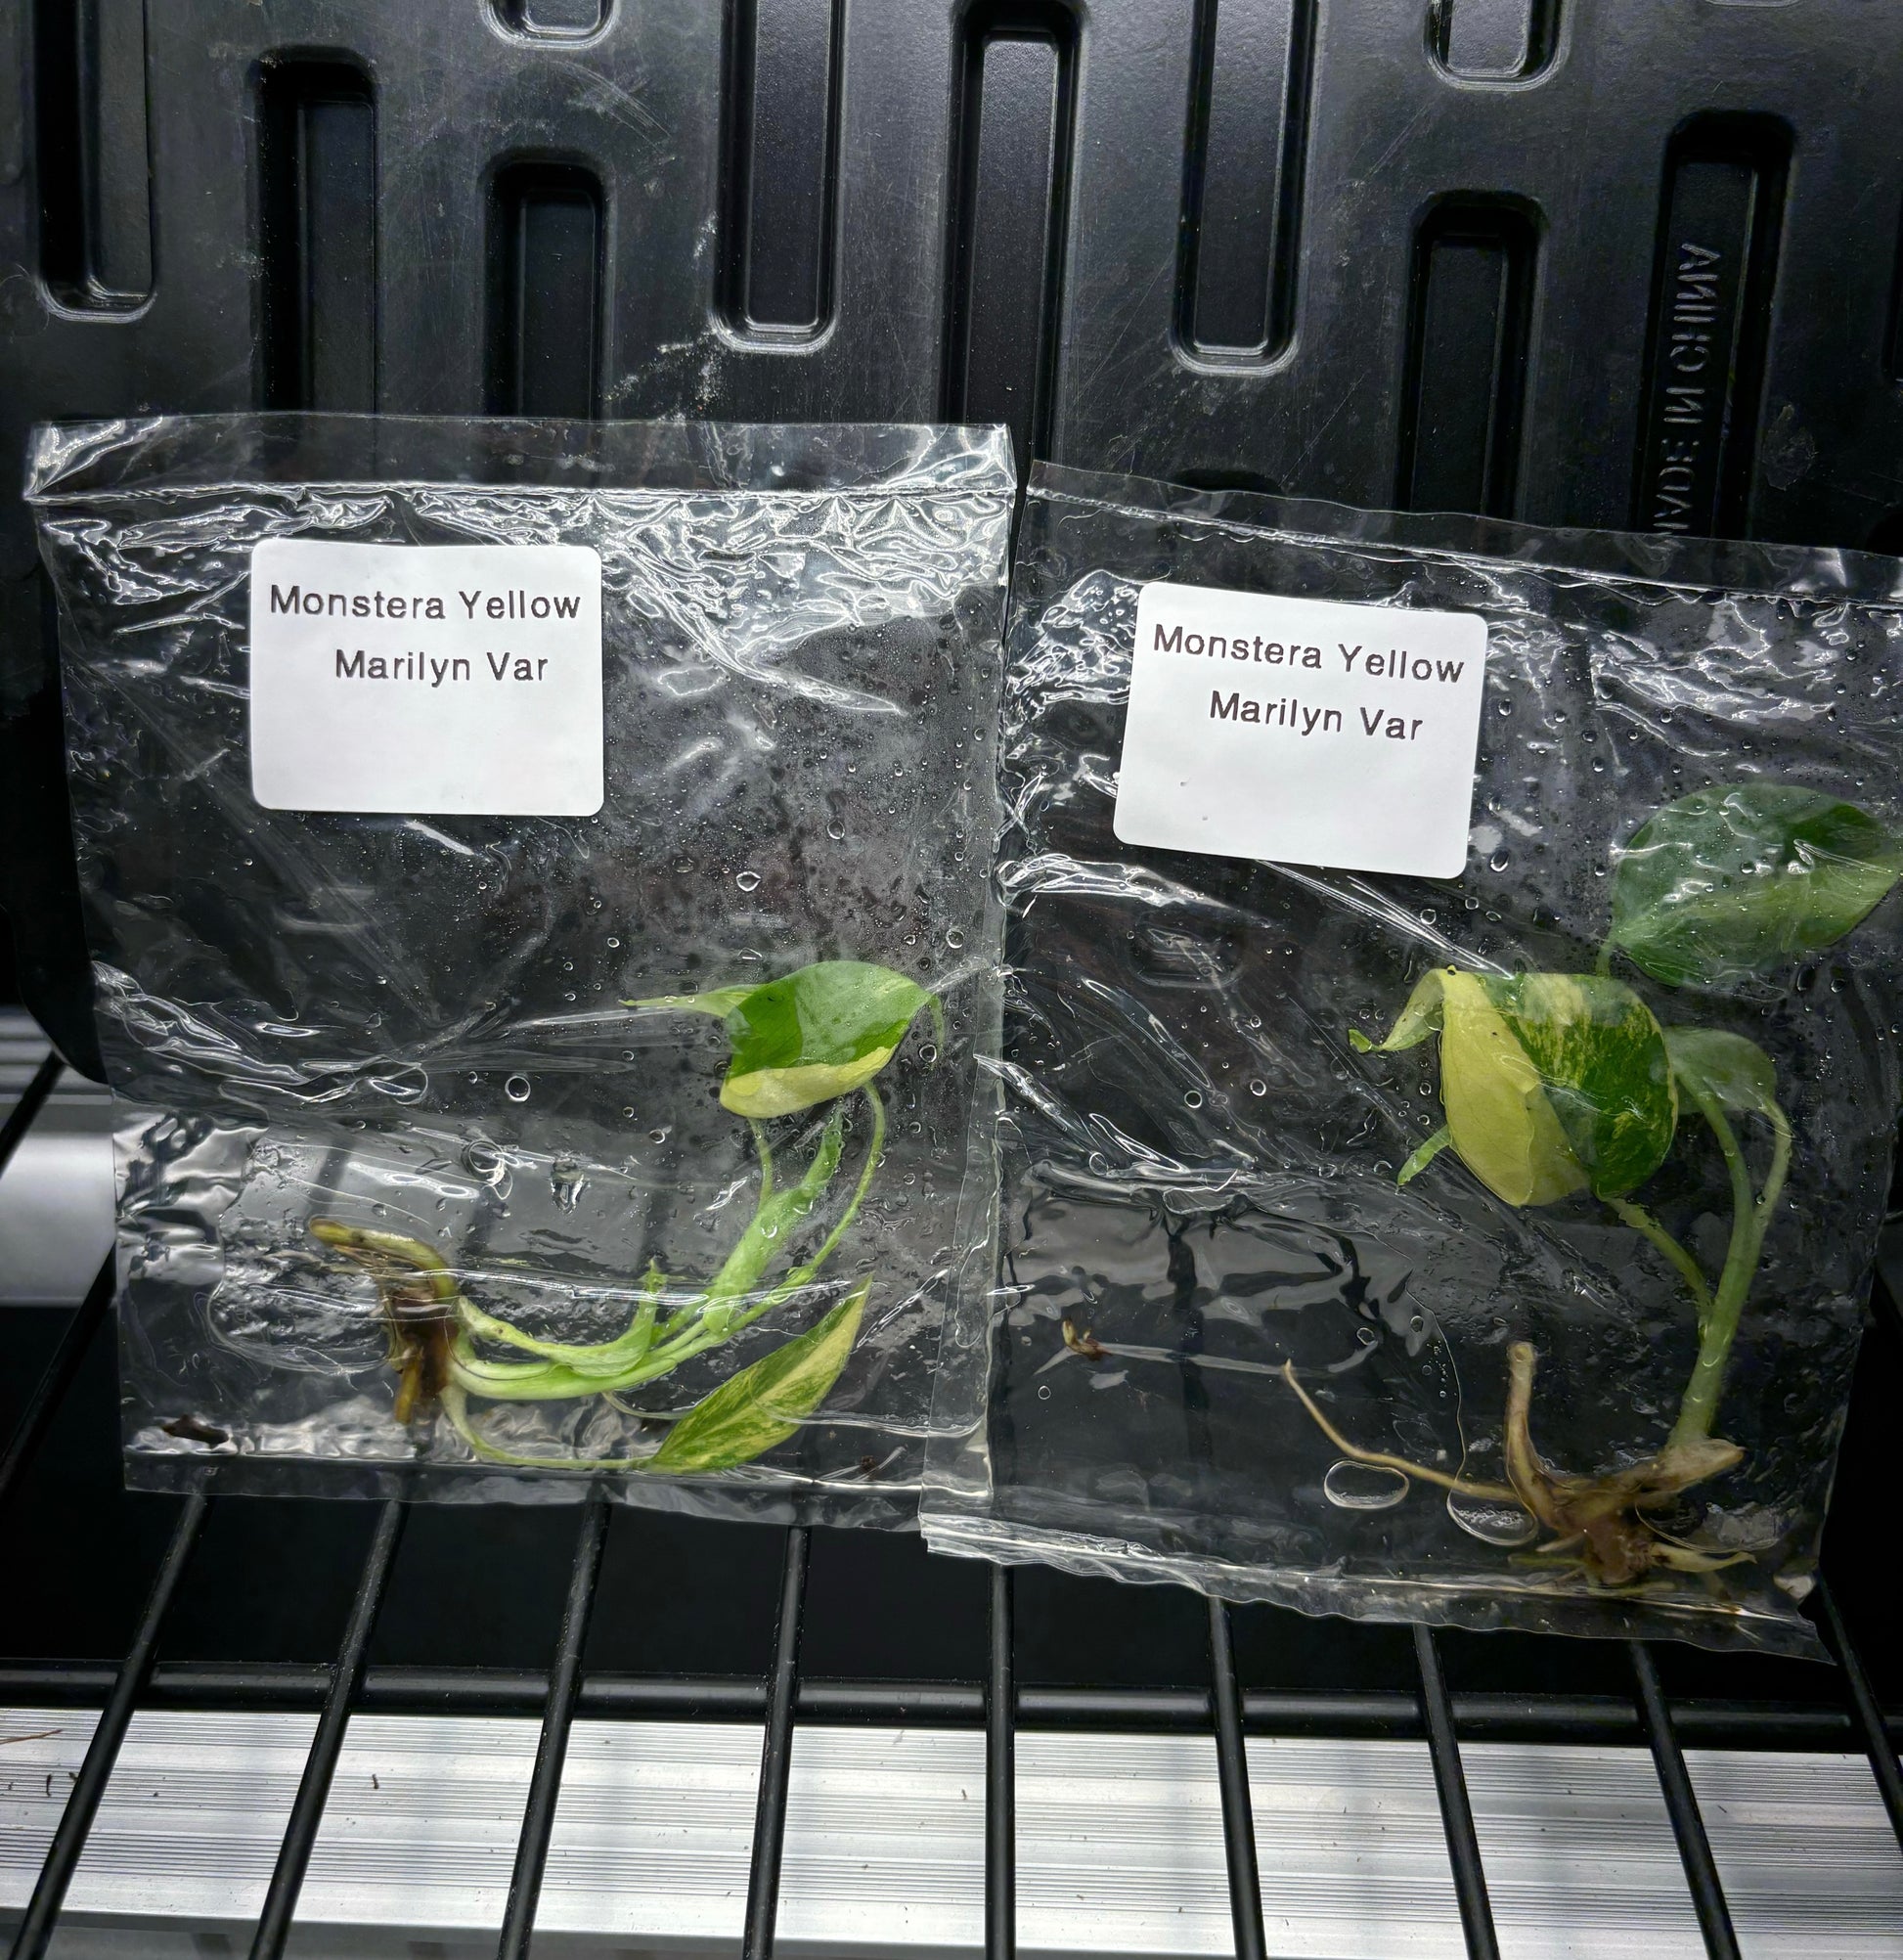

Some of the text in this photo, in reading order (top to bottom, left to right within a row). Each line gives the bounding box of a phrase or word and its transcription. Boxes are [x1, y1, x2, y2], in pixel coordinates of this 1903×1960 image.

[270, 584, 581, 619] Monstera Yellow
[335, 649, 549, 688] Marilyn Var
[1153, 623, 1465, 683] Monstera Yellow
[1210, 690, 1423, 740] Marilyn Var
